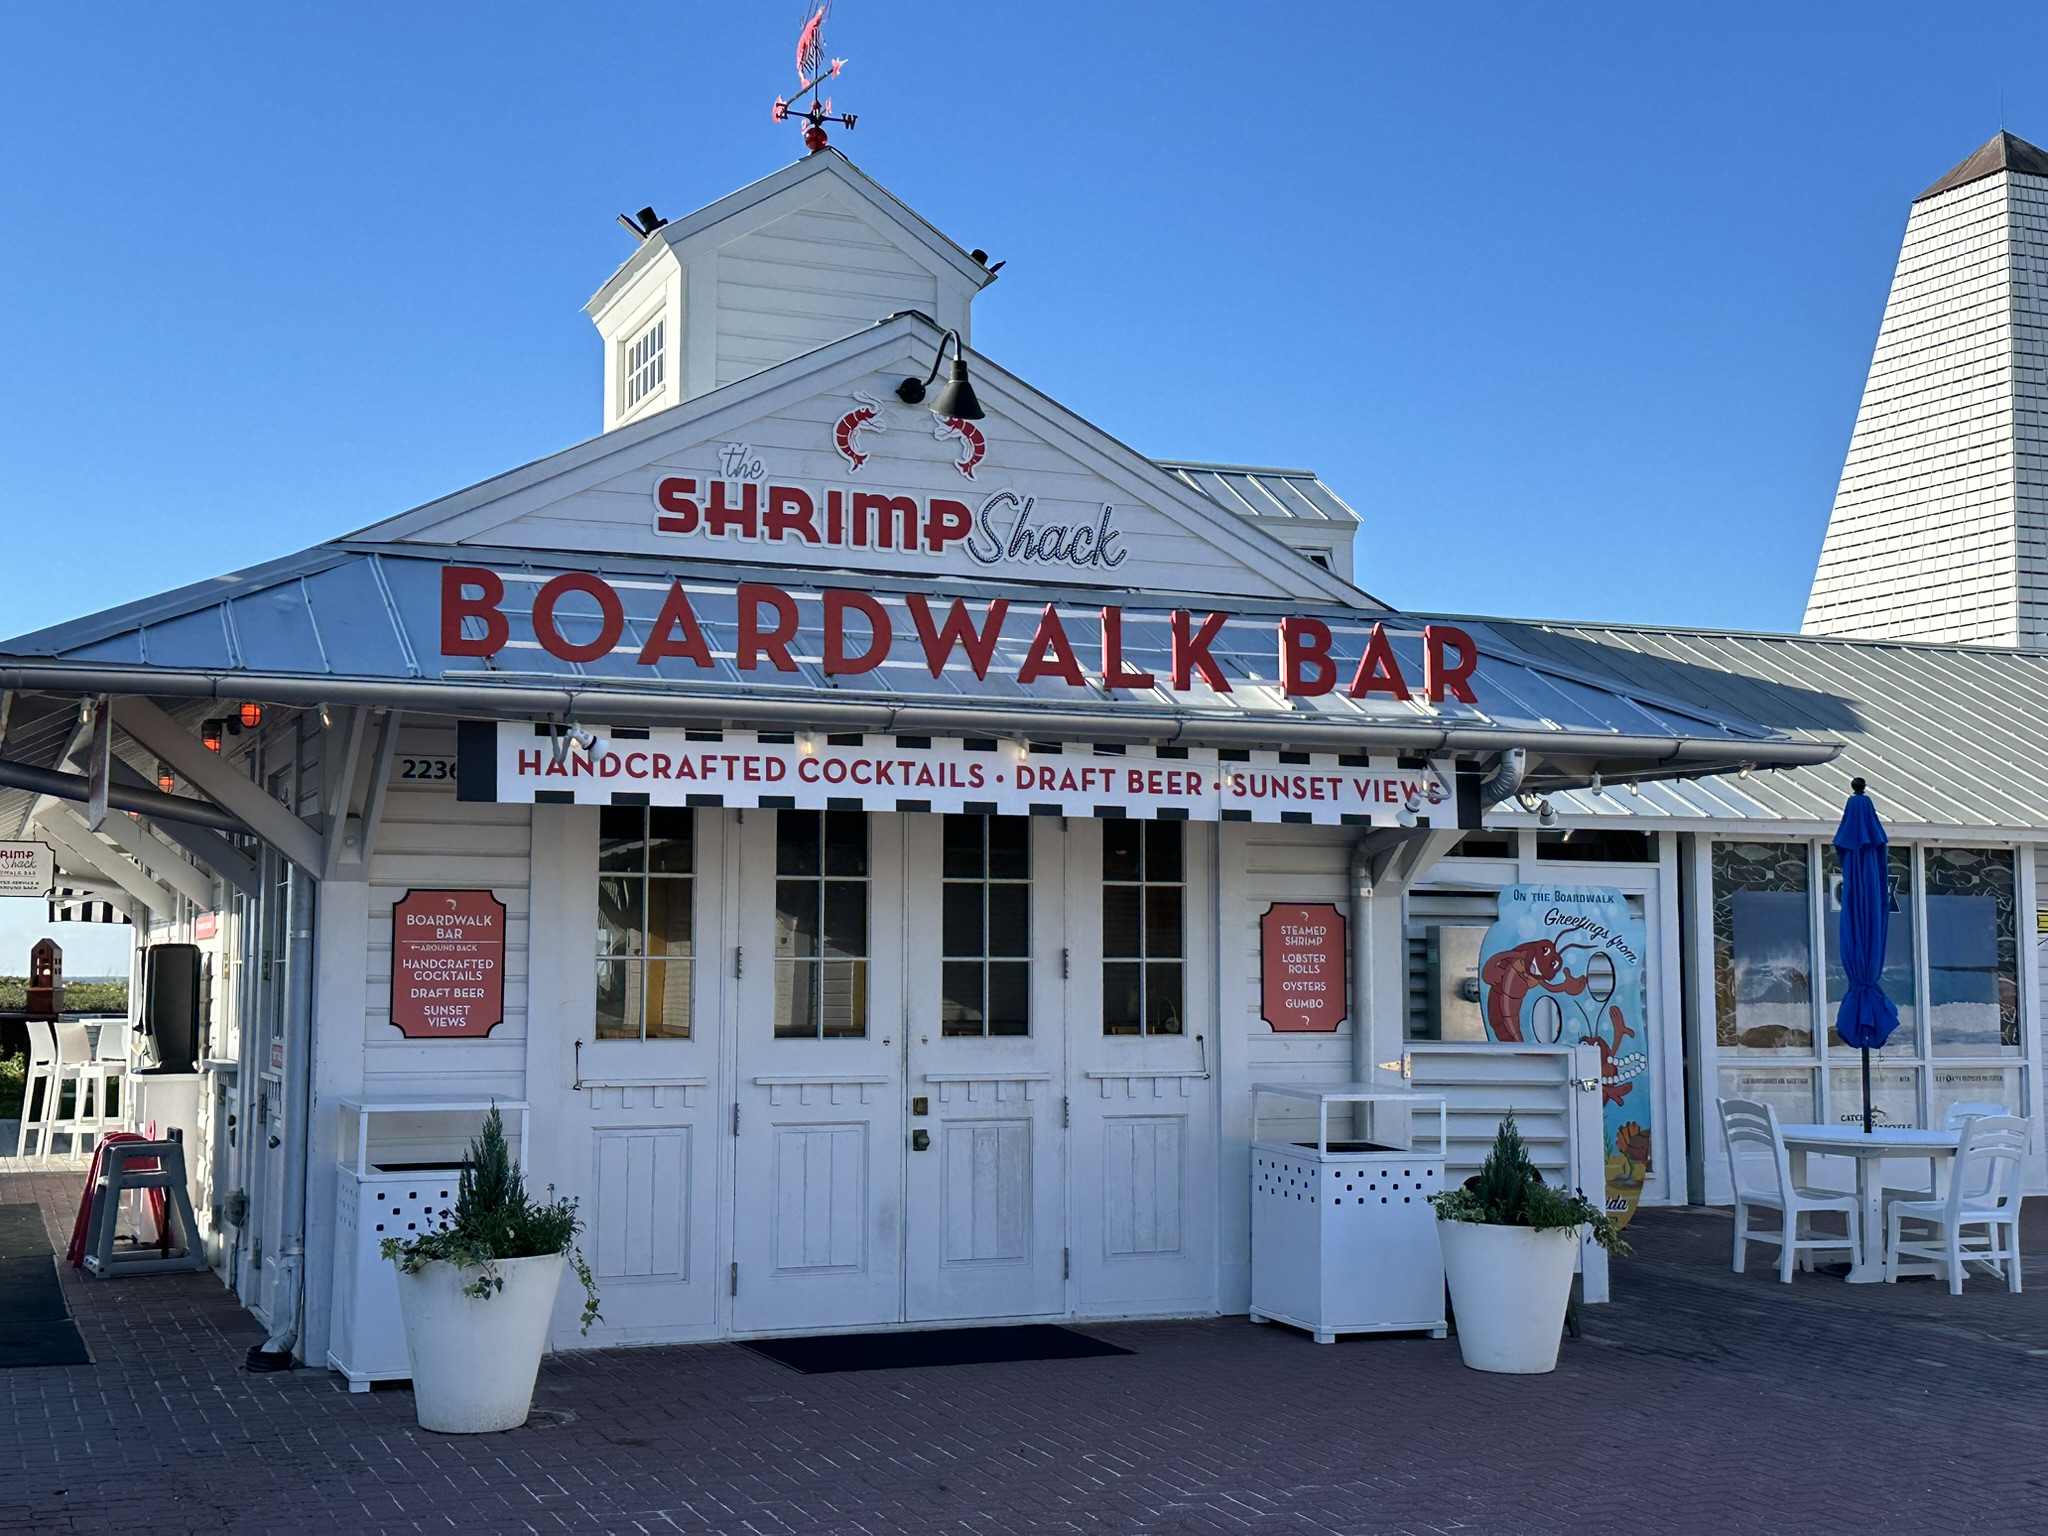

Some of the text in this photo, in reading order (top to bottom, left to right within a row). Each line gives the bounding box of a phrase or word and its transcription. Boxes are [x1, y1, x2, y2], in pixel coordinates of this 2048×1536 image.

[722, 445, 764, 478] the
[656, 477, 1127, 568] SHRIMP Shack
[441, 565, 1478, 704] BOARDWALK BAR
[518, 748, 1442, 805] HANDCRAFTED COCKTAILS DRAFT BEER SUNSET VIEWS
[1554, 890, 1615, 904] BOARDWALK
[406, 914, 492, 926] BOARDWALK
[1544, 907, 1609, 941] Greetings
[436, 928, 463, 939] BAR
[1280, 925, 1327, 936] STEAMED
[1285, 936, 1323, 946] SHRIMP
[420, 944, 478, 952] AROUND BACK
[1606, 935, 1638, 964] from
[1282, 953, 1326, 963] LOBSTER
[402, 959, 494, 969] HANDCRAFTED
[1288, 964, 1320, 974] ROLLS
[414, 970, 483, 981] COCKTAILS
[1282, 981, 1327, 991] OYSTERS
[411, 988, 485, 998] DRAFT BEER
[1285, 999, 1324, 1009] GUMBO
[423, 1005, 471, 1016] SUNSET
[428, 1017, 466, 1027] VIEWS
